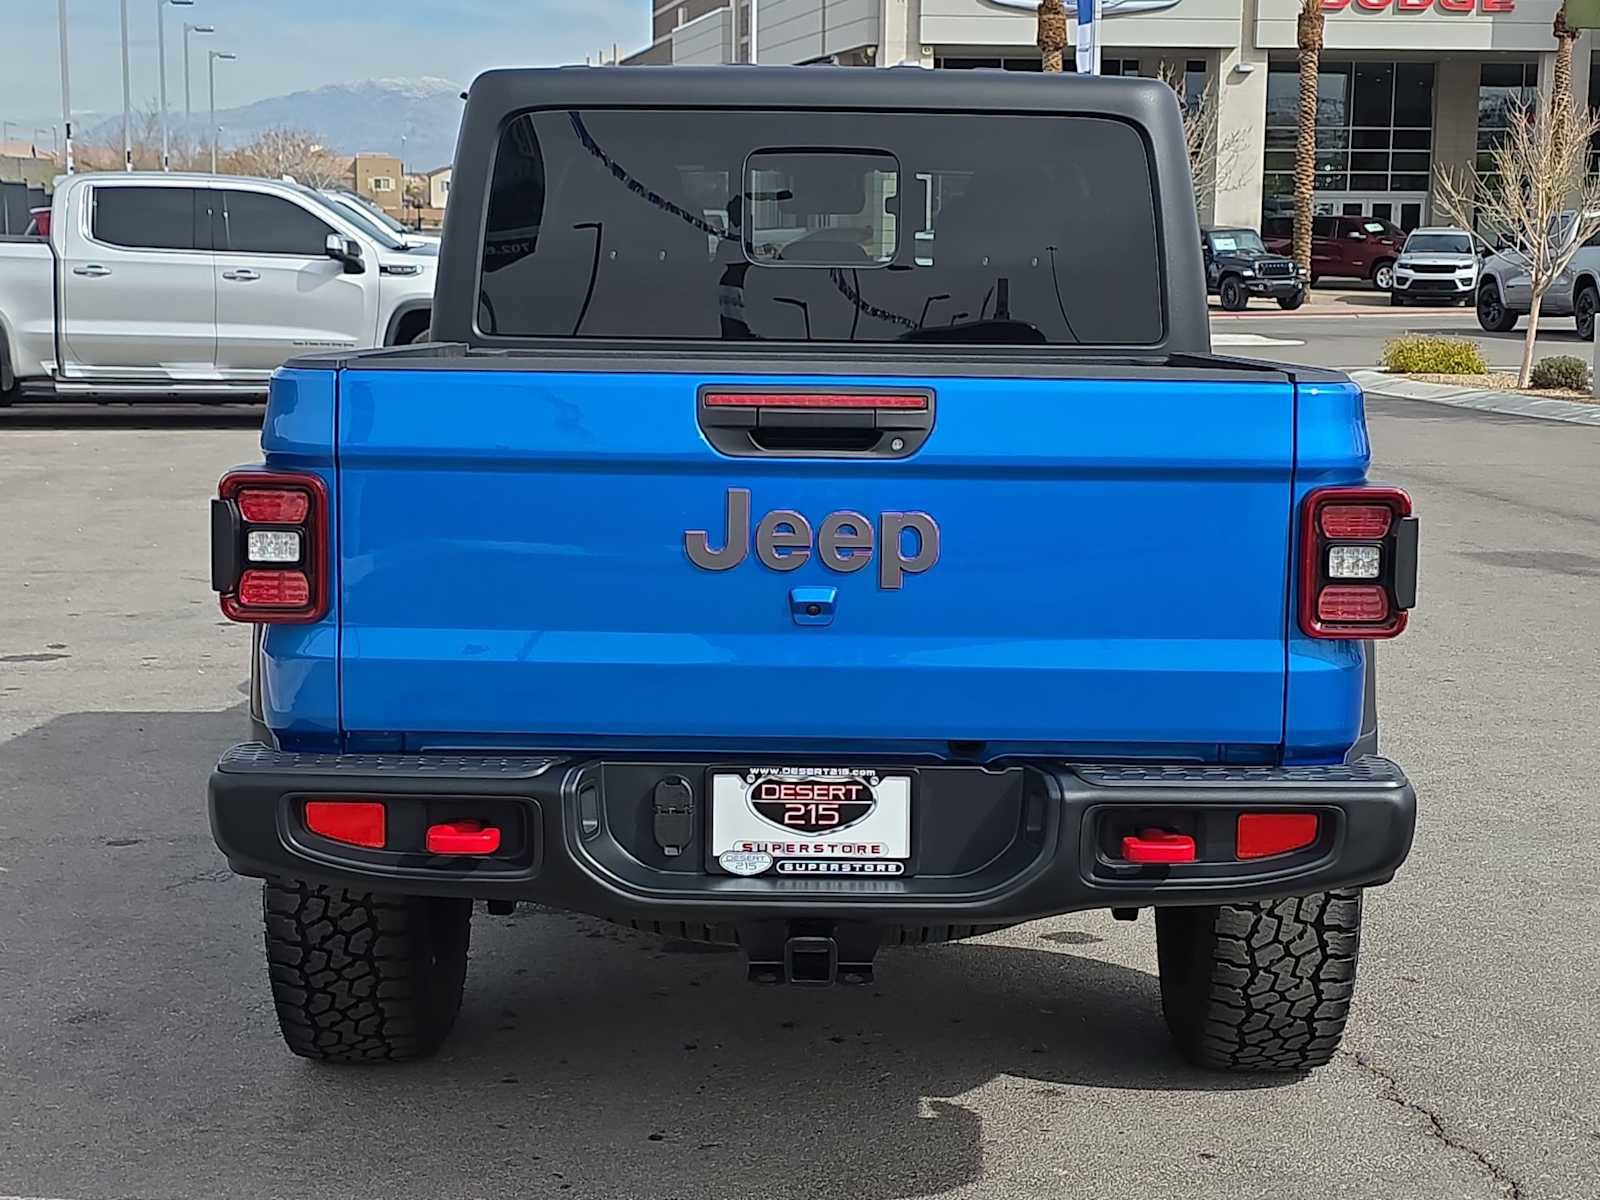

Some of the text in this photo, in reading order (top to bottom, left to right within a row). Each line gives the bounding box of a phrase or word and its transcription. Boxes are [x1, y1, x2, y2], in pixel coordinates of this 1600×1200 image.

[684, 487, 941, 590] Jeep
[761, 784, 863, 800] DESERT
[784, 804, 840, 825] 215
[742, 843, 881, 854] SUPERSTORE
[735, 862, 757, 871] 215
[783, 863, 897, 872] SUPERSTORE
